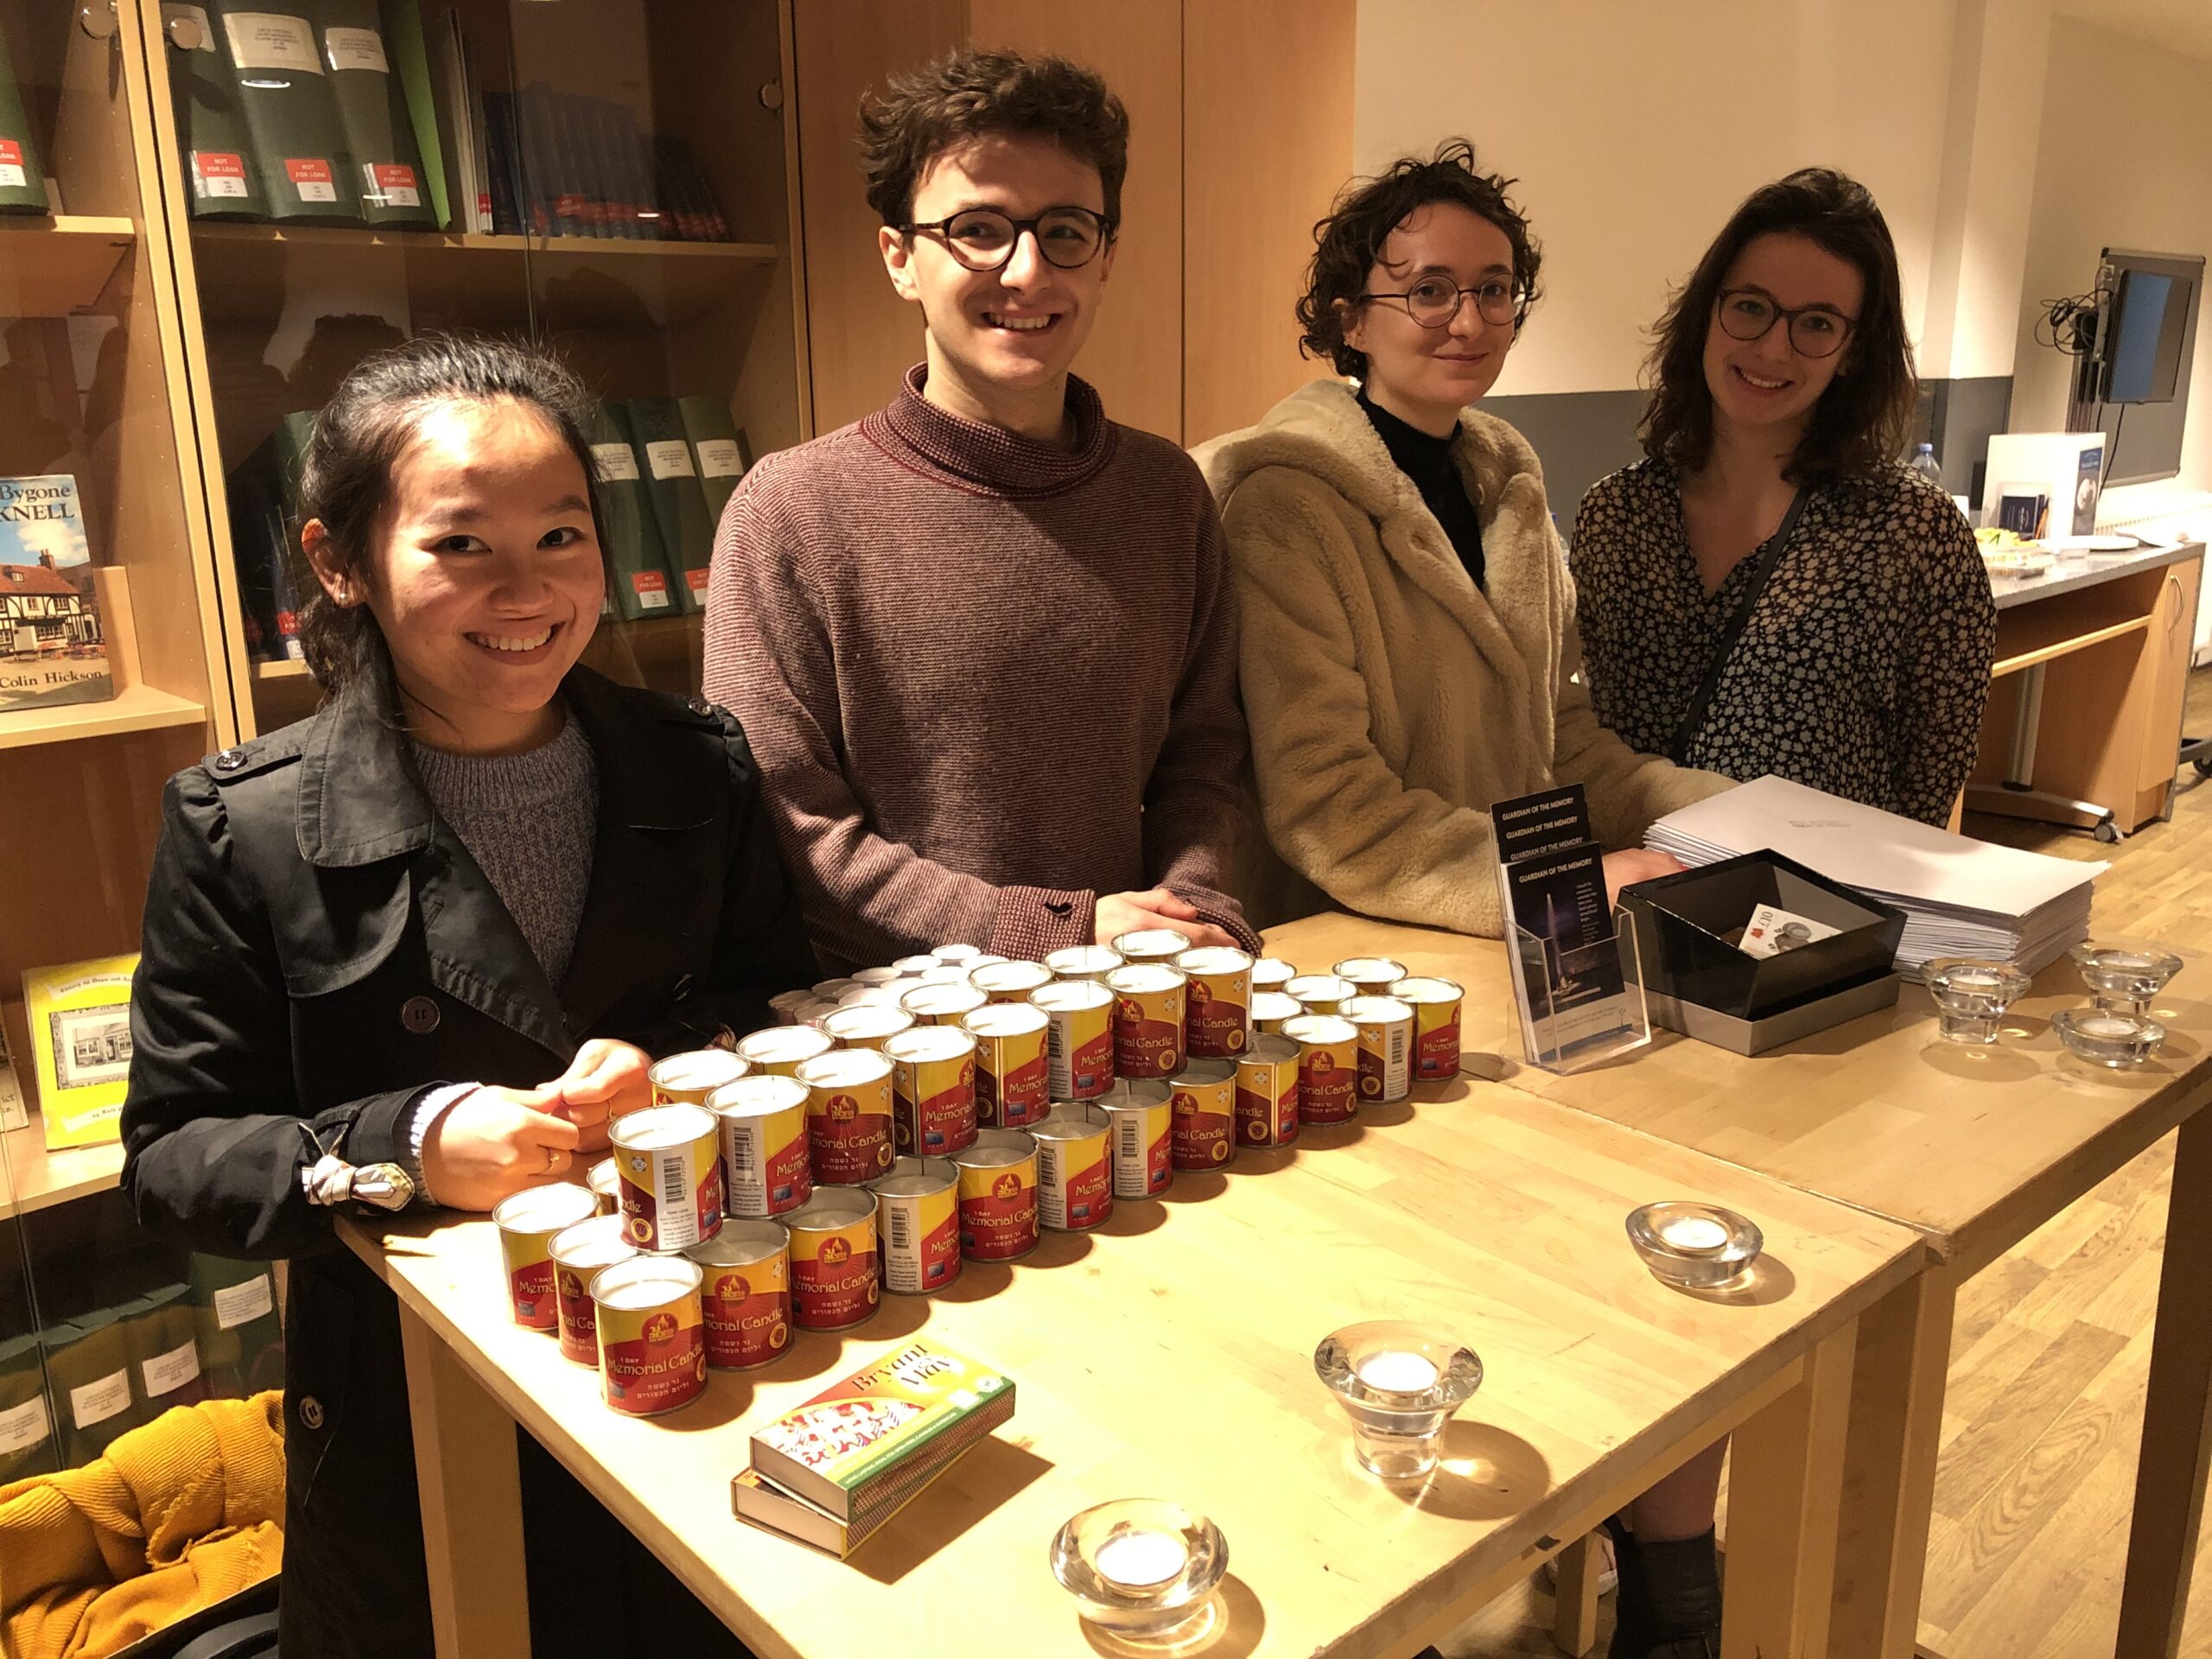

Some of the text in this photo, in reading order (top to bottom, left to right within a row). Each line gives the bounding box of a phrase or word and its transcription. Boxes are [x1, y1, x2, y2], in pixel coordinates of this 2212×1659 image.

[0, 484, 71, 503] Bygone
[0, 671, 103, 689] Colin Hickson
[1502, 797, 1574, 821] GUARDIAN OF THE MEMORY
[1506, 816, 1578, 840] GUARDIAN OF THE MEMORY
[1510, 836, 1583, 861] GUARDIAN OF THE MEMORY
[1518, 857, 1592, 883] GUARDIAN OF THE MEMORY
[1758, 911, 1774, 928] £10
[1202, 1017, 1238, 1028] Candle
[1136, 1036, 1173, 1048] Candle
[849, 1129, 887, 1148] Candle
[1190, 1128, 1225, 1141] Candle
[962, 1212, 1014, 1227] Memorial
[741, 1307, 783, 1331] Candle
[607, 1357, 667, 1376] Memorial
[851, 1344, 929, 1391] Bryant
